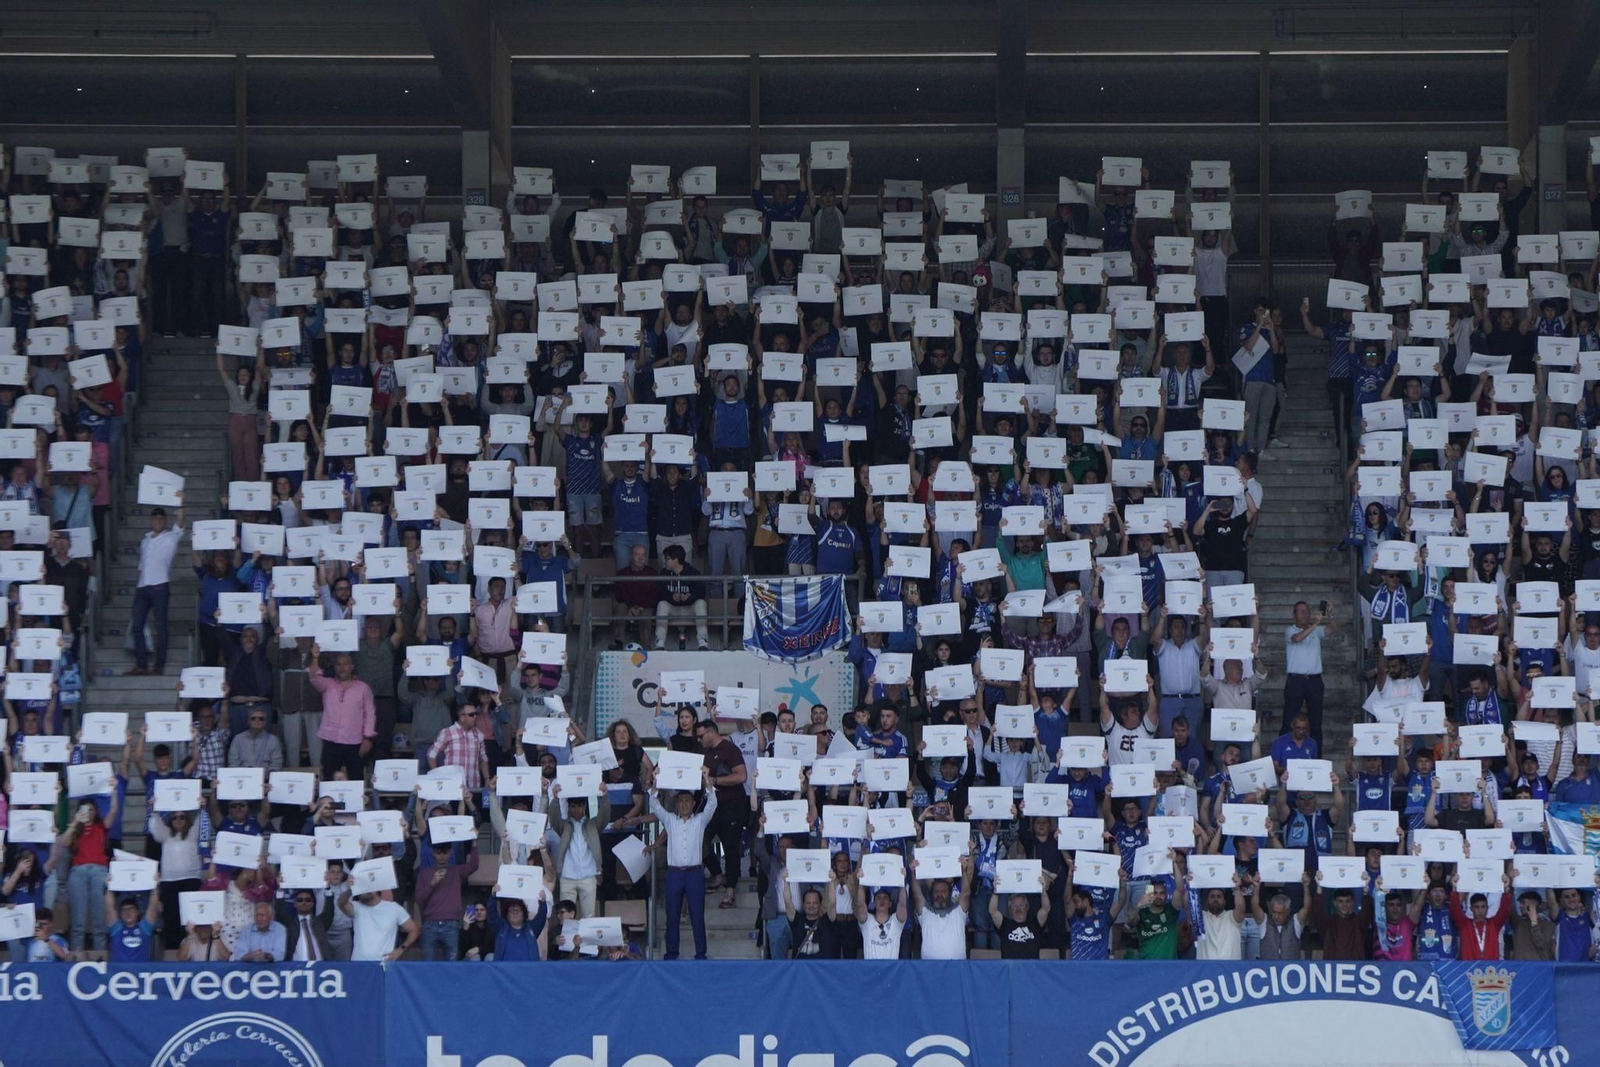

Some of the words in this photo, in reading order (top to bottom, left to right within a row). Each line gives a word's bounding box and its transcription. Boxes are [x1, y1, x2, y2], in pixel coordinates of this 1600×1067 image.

[467, 195, 485, 205] 328
[1002, 194, 1020, 204] 328
[67, 961, 347, 1001] Cervecería
[1088, 963, 1382, 1067] DISTRIBUCIONES
[1392, 970, 1448, 1010] CA
